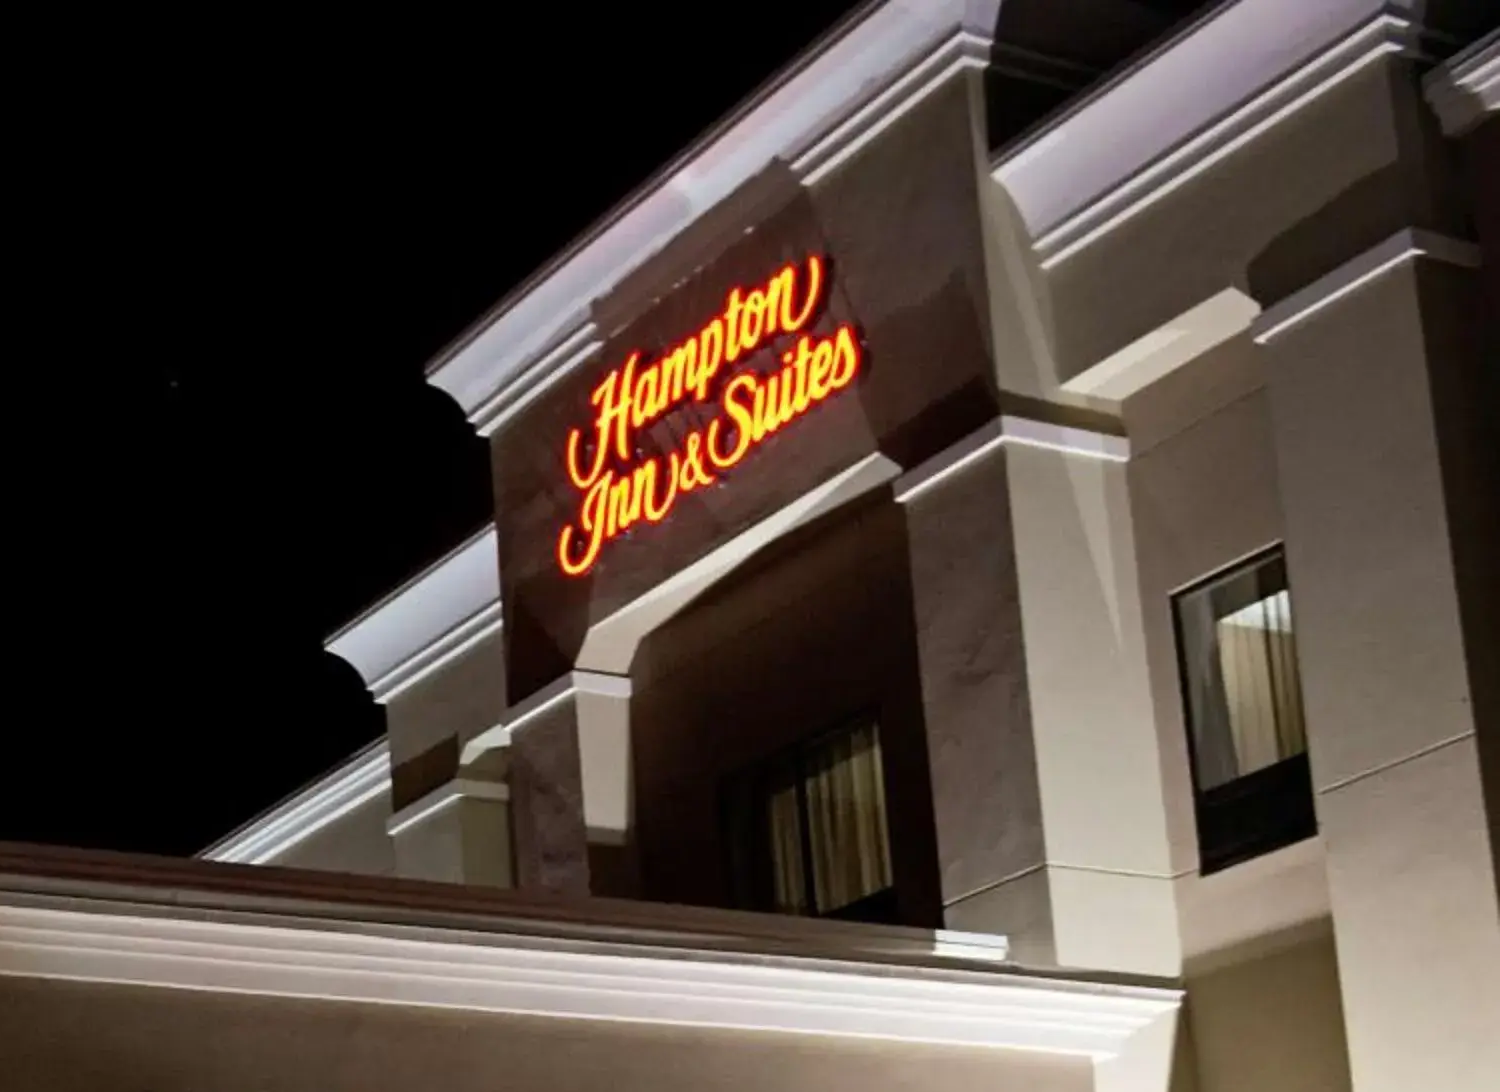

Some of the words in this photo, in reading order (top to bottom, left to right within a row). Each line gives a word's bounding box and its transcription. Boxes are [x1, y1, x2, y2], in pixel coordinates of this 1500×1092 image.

[558, 452, 681, 576] Inn
[679, 431, 714, 492] &
[707, 324, 859, 469] Suites
[567, 254, 823, 490] Hampton
